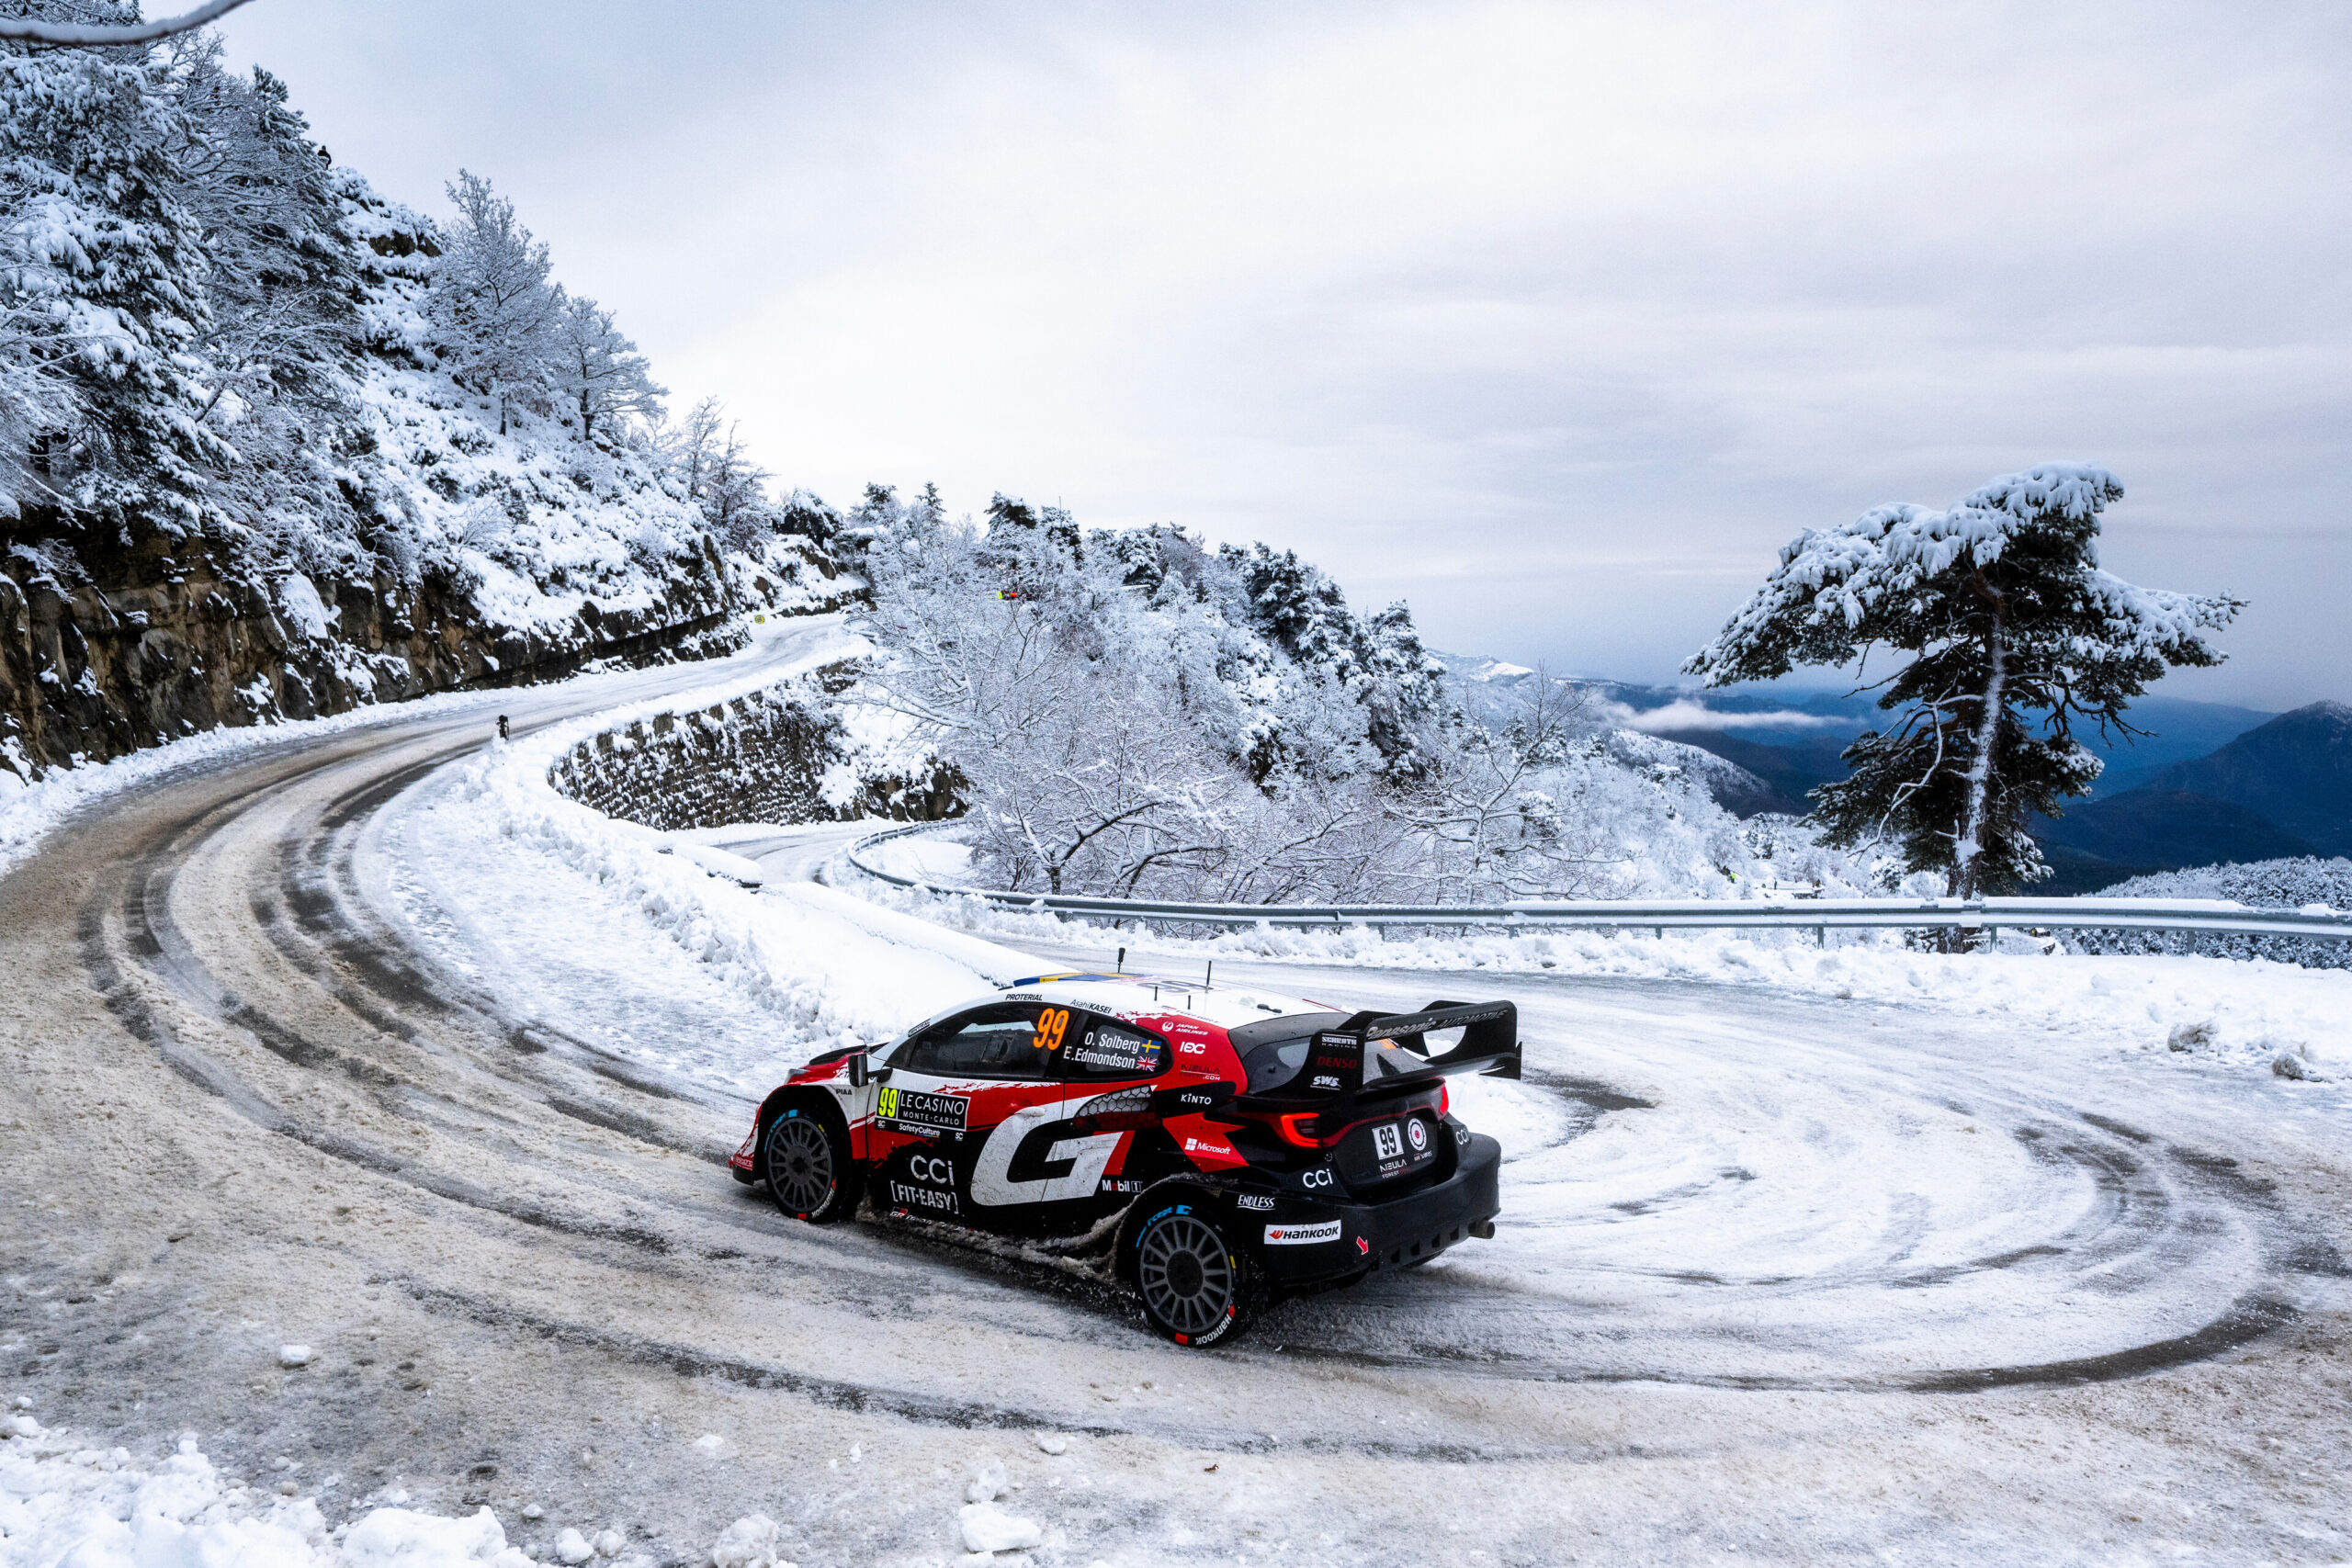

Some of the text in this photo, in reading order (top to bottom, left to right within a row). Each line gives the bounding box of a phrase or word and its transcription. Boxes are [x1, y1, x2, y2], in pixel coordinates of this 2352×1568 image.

[1005, 993, 1043, 1001] PROTERIAL
[1033, 1008, 1069, 1051] 99
[1365, 1017, 1437, 1040] Panasonic
[1084, 1032, 1140, 1055] O. Solberg
[1316, 1055, 1357, 1069] DENSO
[1313, 1076, 1340, 1087] SWS
[878, 1087, 898, 1118] 99
[900, 1093, 965, 1115] LE CASINO
[899, 1122, 941, 1136] SafetyCulture
[1196, 1142, 1231, 1155] Microsoft
[1378, 1127, 1396, 1156] 99
[1102, 1180, 1130, 1191] Mobil
[1238, 1194, 1275, 1208] ENDLESS
